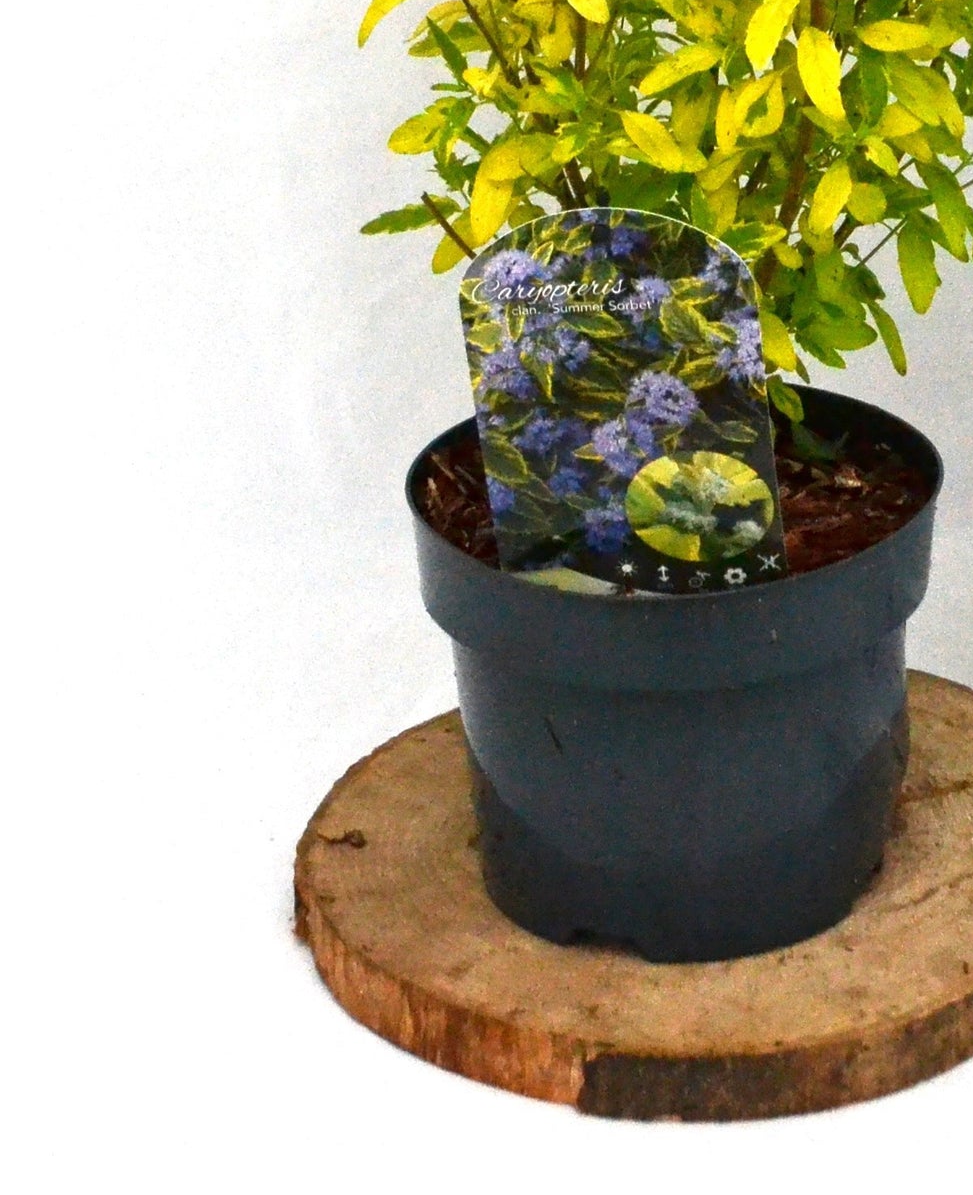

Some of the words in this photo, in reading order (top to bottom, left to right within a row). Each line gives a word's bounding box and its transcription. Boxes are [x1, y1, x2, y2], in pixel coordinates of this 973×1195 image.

[471, 278, 627, 304] Caryopteris
[511, 304, 541, 316] clan.
[548, 303, 604, 314] 'Summer
[609, 299, 655, 312] Sorbet'
